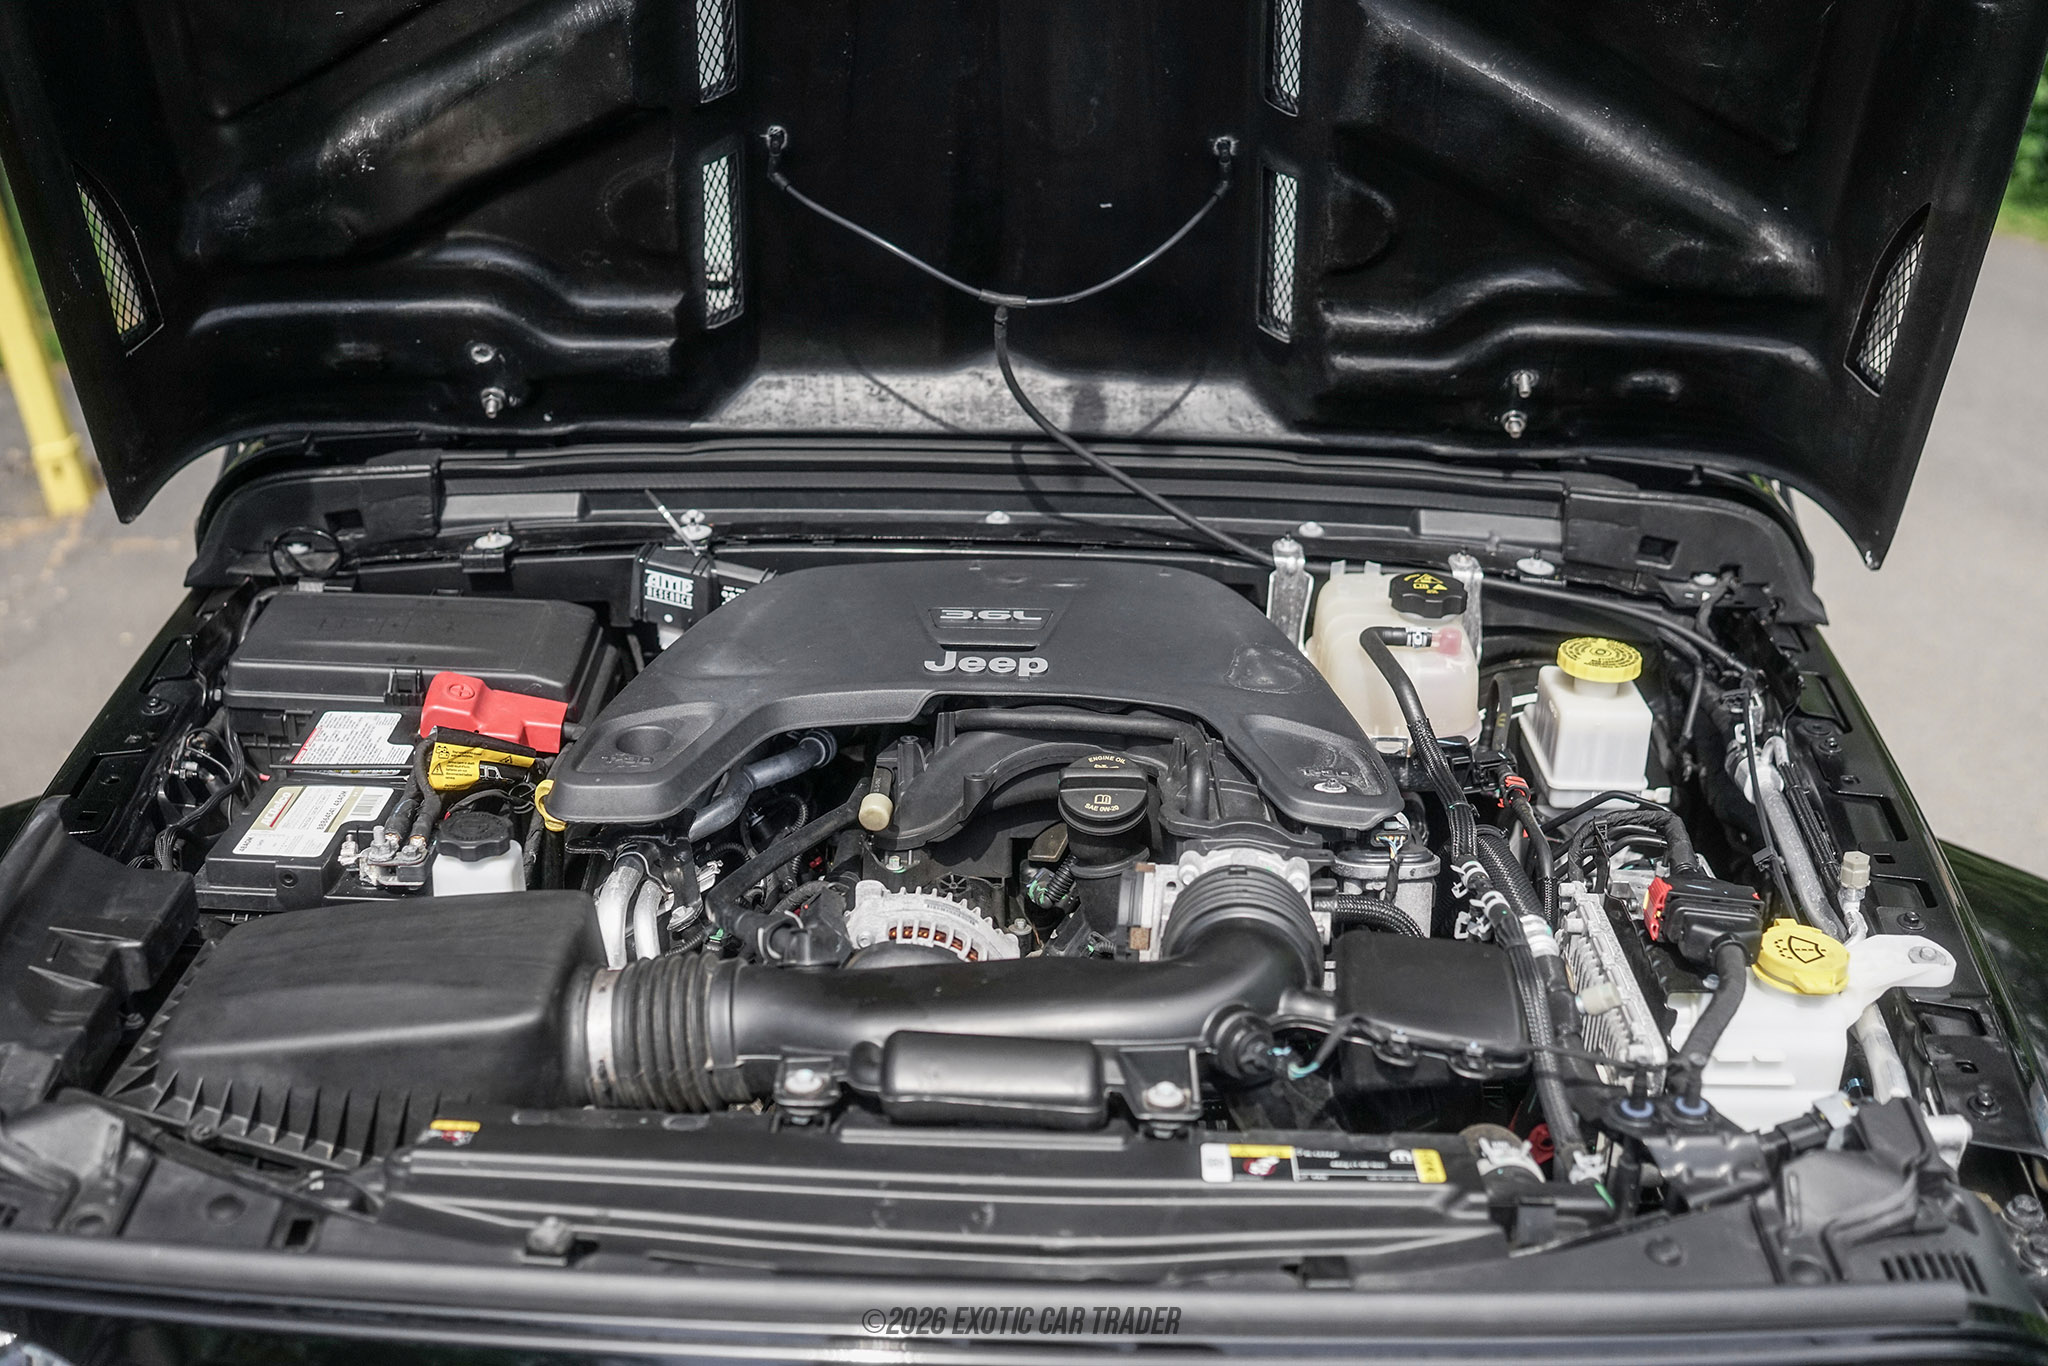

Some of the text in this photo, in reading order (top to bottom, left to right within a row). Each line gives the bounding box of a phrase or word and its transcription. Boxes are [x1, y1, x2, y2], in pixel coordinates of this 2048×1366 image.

[646, 586, 693, 606] RESEARCH
[940, 609, 1042, 621] 3.6L
[924, 651, 1049, 678] Jeep
[1088, 755, 1126, 765] ENGINE OIL
[333, 790, 347, 807] 48AGM
[261, 792, 291, 827] ACDelco
[1084, 803, 1120, 813] SAE 0W-20
[239, 836, 254, 852] 48AGM
